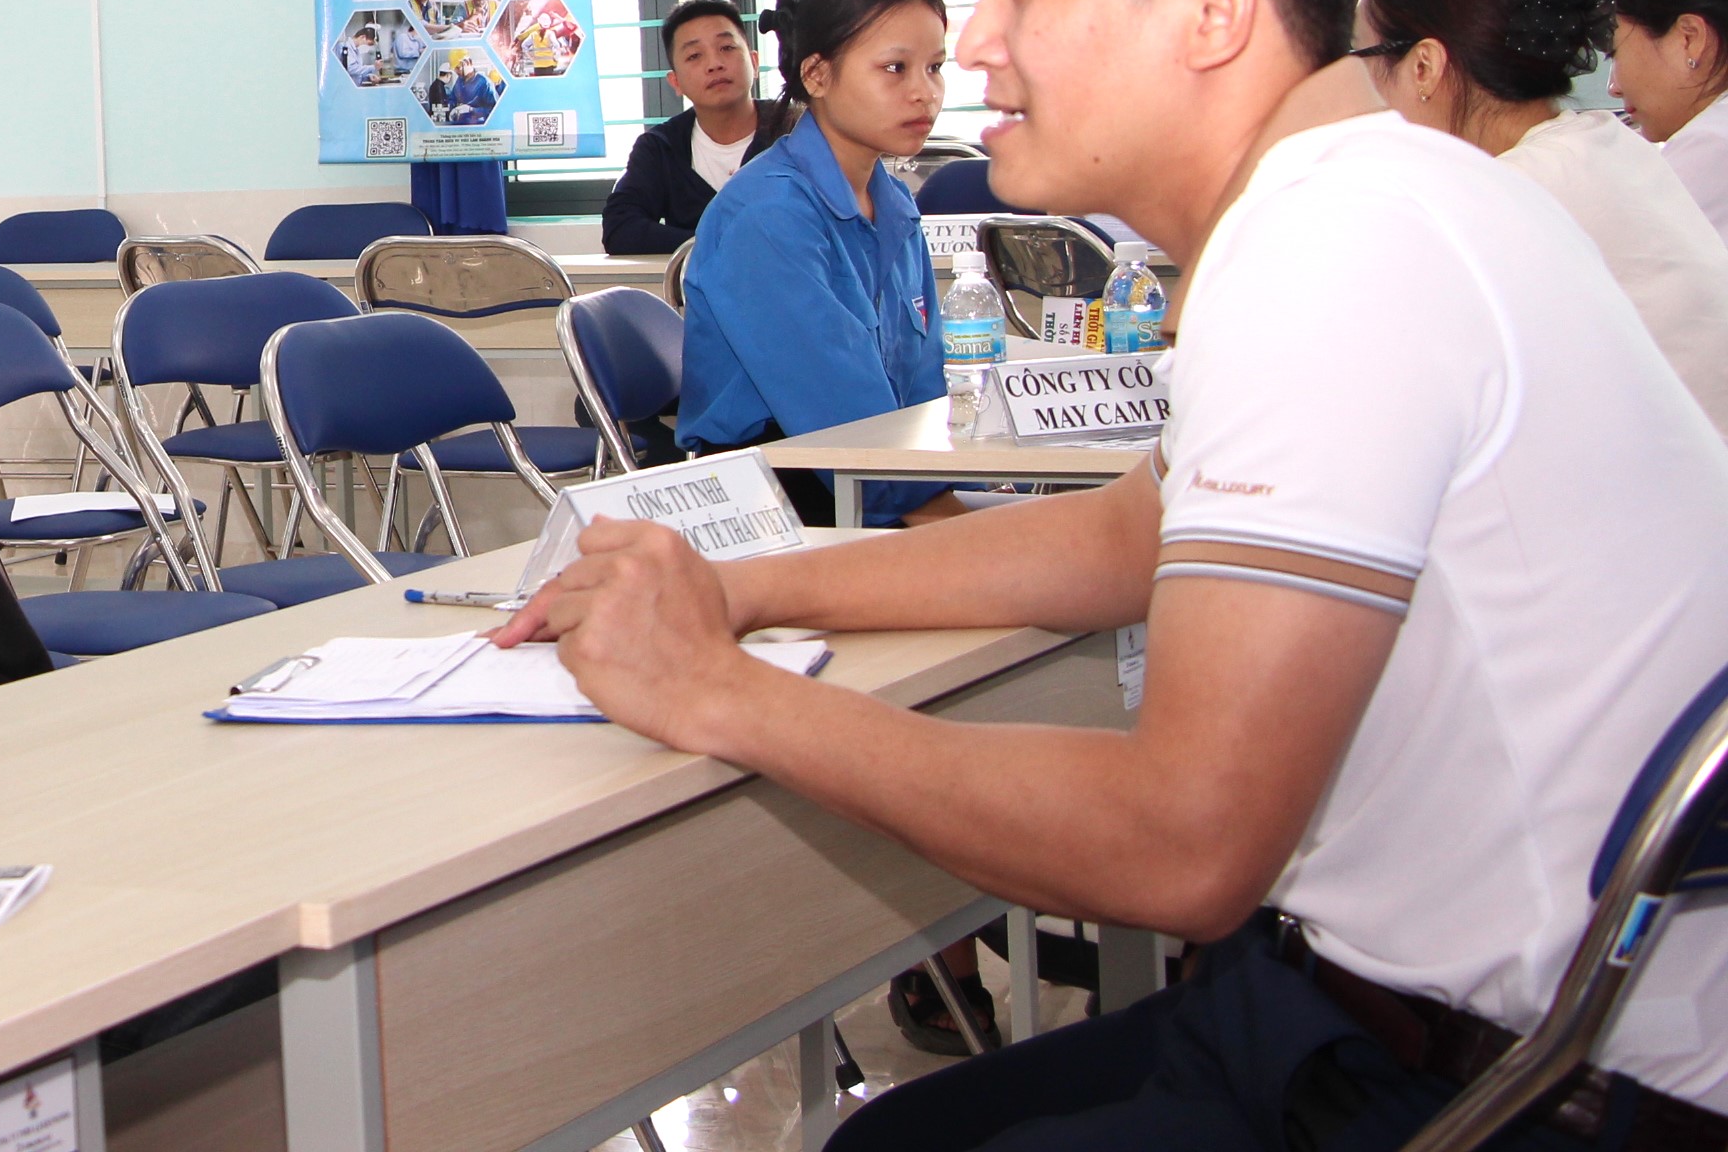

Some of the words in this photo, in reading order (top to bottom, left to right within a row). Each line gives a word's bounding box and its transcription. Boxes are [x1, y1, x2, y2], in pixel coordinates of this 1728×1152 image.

[935, 224, 955, 236] TY
[944, 332, 992, 354] Sanna
[1005, 368, 1077, 398] CÔNG
[1079, 368, 1112, 392] TY
[1034, 405, 1088, 430] MAY
[1094, 400, 1153, 426] CAM
[627, 486, 672, 520] CÔNG
[666, 484, 692, 512] TY
[684, 476, 730, 508] TNHH
[703, 514, 730, 548] TẾ
[722, 507, 760, 545] THÁI
[754, 505, 790, 541] VIỆT
